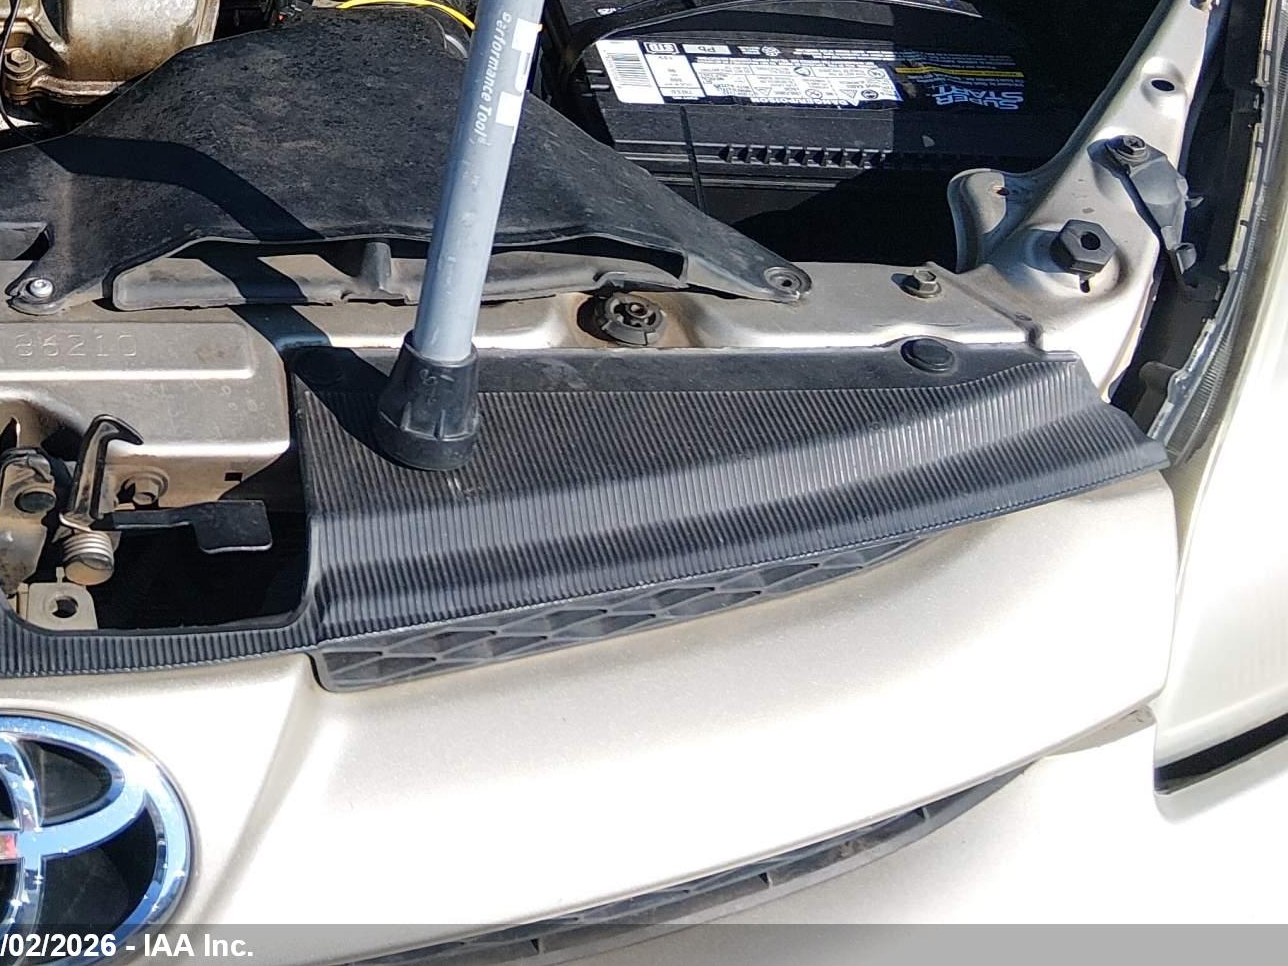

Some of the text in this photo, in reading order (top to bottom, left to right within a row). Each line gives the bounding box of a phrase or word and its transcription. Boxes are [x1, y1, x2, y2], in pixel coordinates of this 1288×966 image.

[481, 10, 512, 101] Performance
[935, 85, 1024, 103] START
[935, 94, 1019, 110] SUPER
